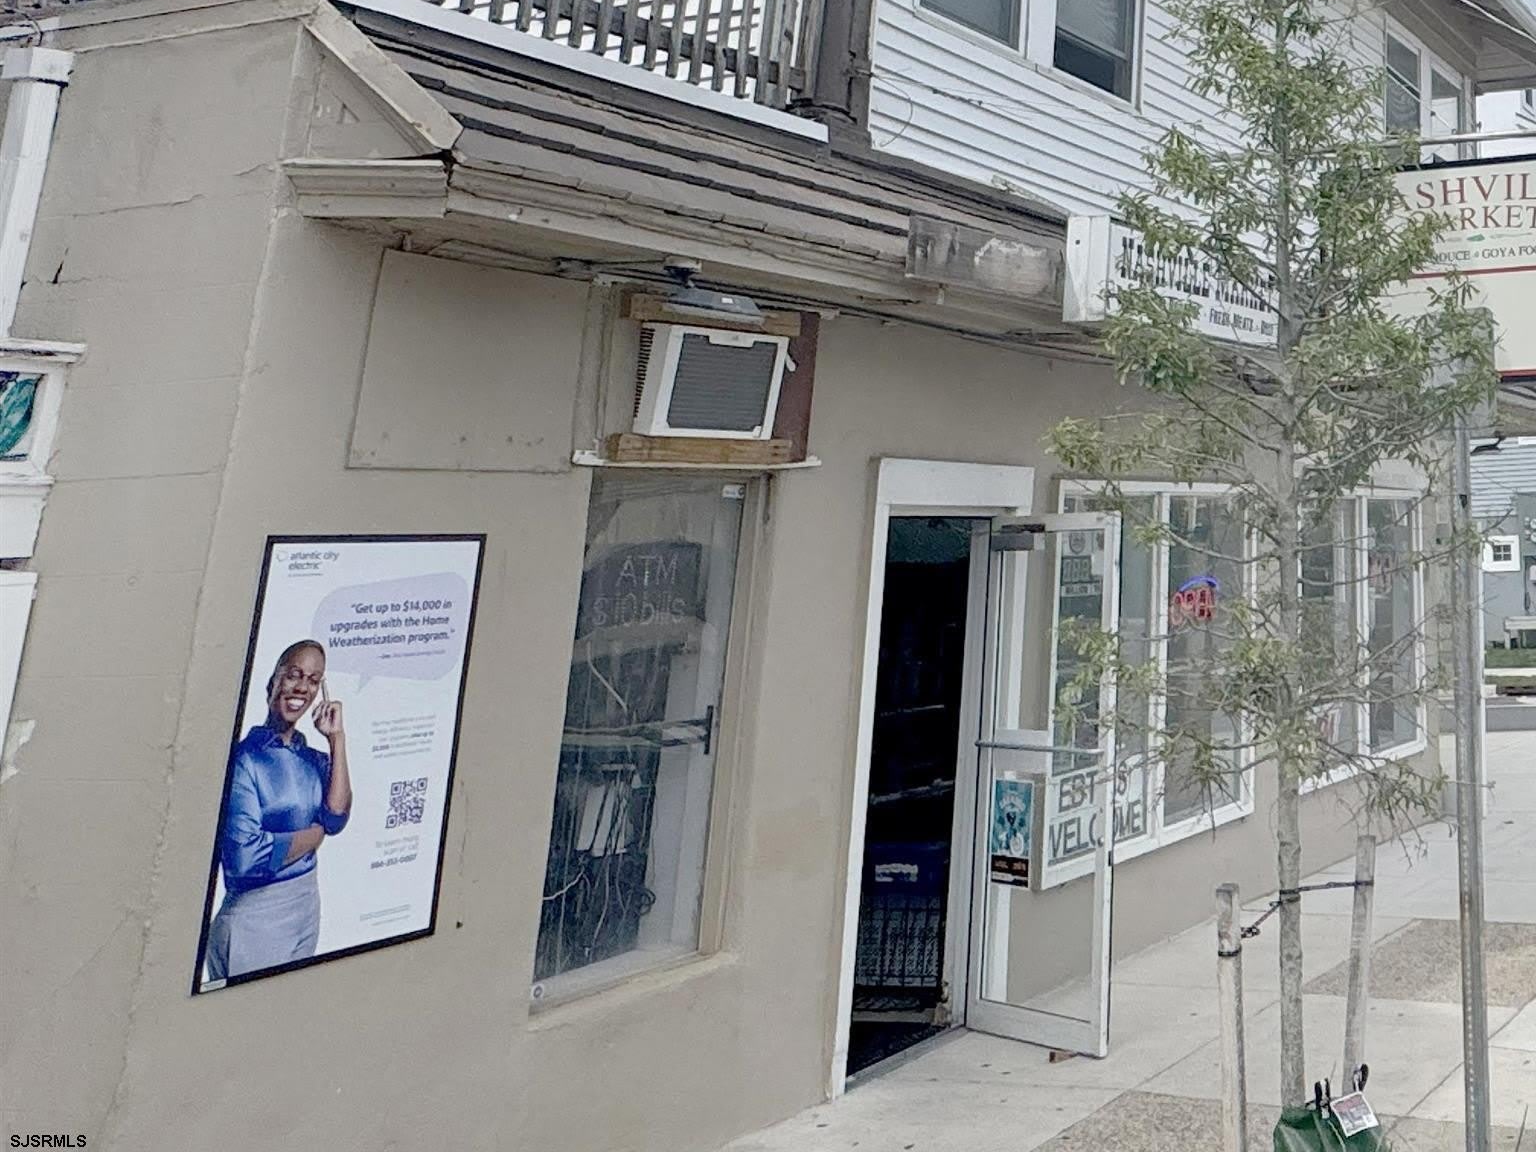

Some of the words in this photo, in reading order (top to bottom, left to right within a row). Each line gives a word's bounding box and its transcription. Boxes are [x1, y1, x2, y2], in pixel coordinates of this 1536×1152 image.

[1482, 247, 1516, 259] GOYA
[290, 551, 322, 561] atlantic
[323, 551, 340, 562] city
[288, 561, 320, 570] electric
[615, 554, 679, 587] ATM
[376, 604, 389, 615] up
[390, 602, 401, 612] to
[443, 599, 452, 610] in
[330, 619, 378, 633] upgrades
[380, 617, 402, 629] with
[404, 616, 420, 627] the
[422, 615, 449, 626] Home
[328, 632, 406, 648] Weatherization
[1059, 771, 1098, 813] EBT
